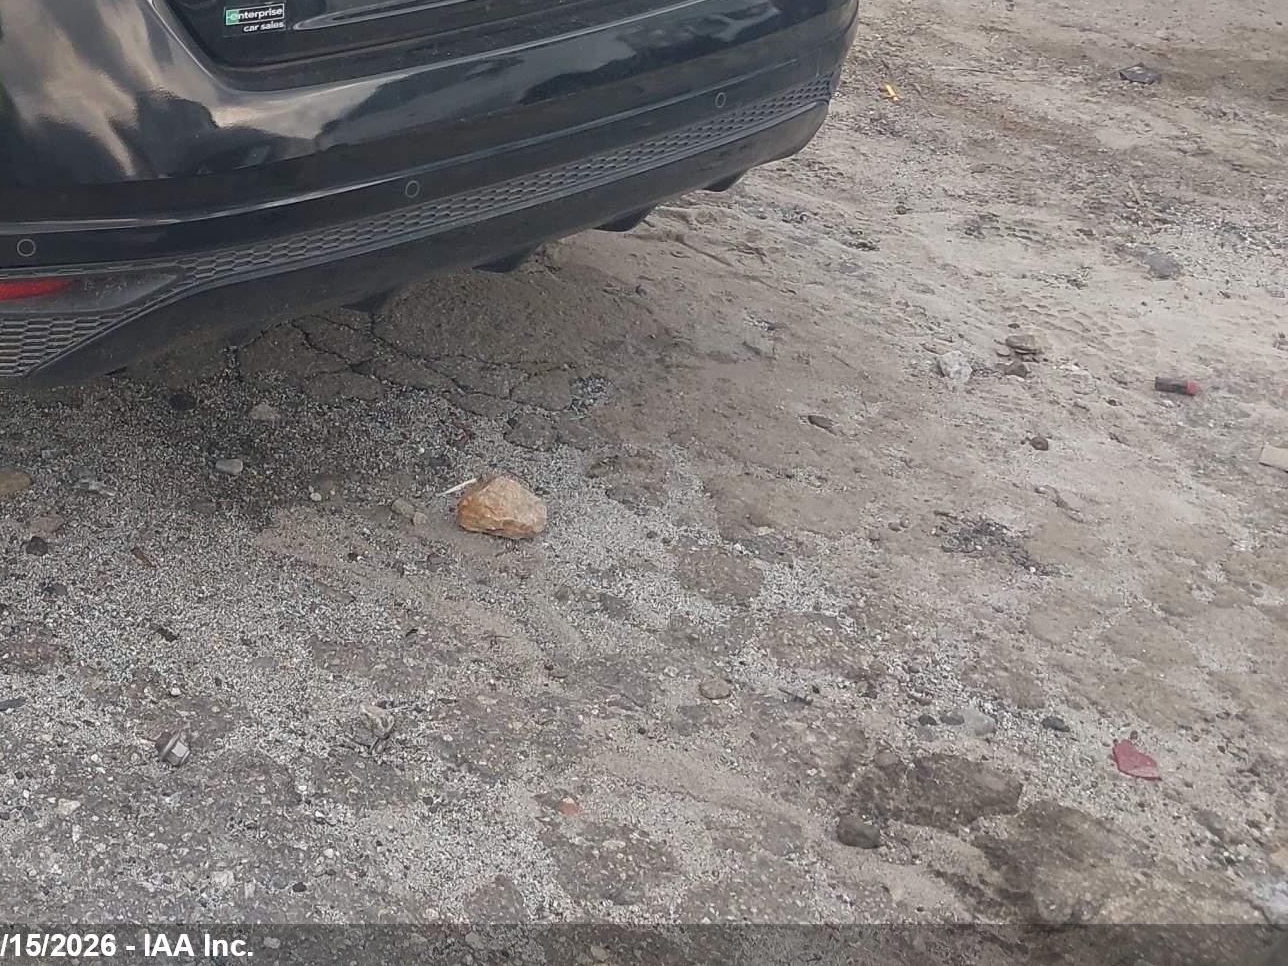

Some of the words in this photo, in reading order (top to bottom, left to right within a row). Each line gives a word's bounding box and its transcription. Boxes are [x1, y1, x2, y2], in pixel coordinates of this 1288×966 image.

[227, 7, 283, 21] enterprise
[243, 24, 259, 32] car
[260, 21, 284, 31] sales
